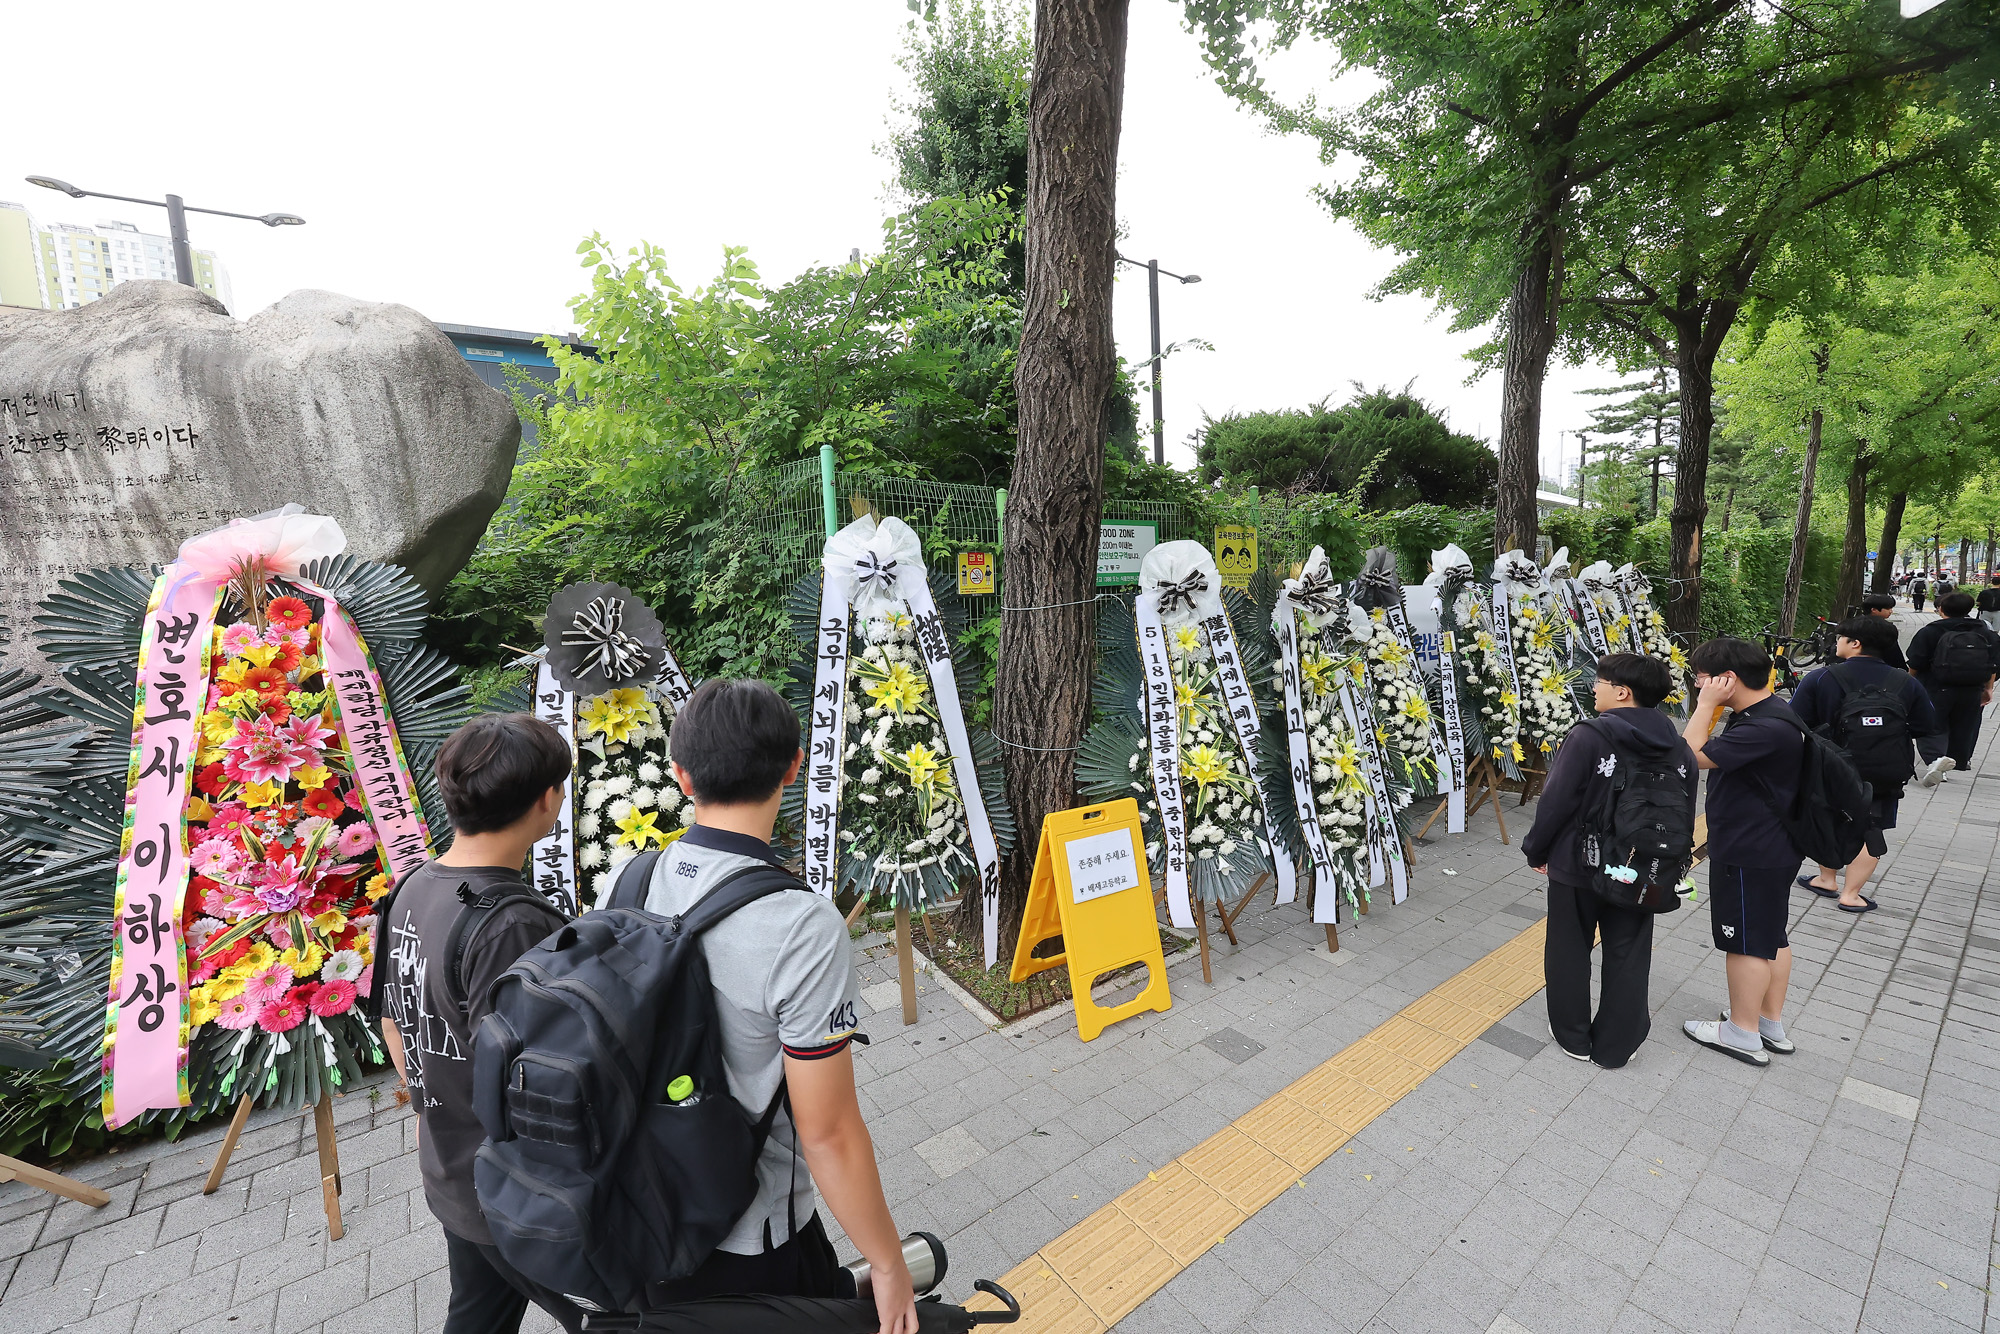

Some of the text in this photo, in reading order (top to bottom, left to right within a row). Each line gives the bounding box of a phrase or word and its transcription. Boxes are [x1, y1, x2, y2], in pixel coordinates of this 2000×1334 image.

[1102, 541, 1118, 549] 200m
[1119, 529, 1135, 538] ZONE
[969, 554, 983, 562] 금연
[335, 669, 384, 718] 배재학당
[1217, 652, 1248, 700] 배재고
[1150, 683, 1175, 754] 민주화운동
[351, 720, 391, 770] 자유정신
[807, 617, 846, 896] 극우 세뇌개를 박멸하
[1156, 758, 1178, 801] 참가인
[119, 612, 199, 1032] 변호사 이하상
[675, 861, 699, 878] 1885
[1078, 849, 1130, 870] 존중해 주세요.
[1087, 875, 1128, 893] 배재고등학교
[829, 1000, 858, 1033] 143
